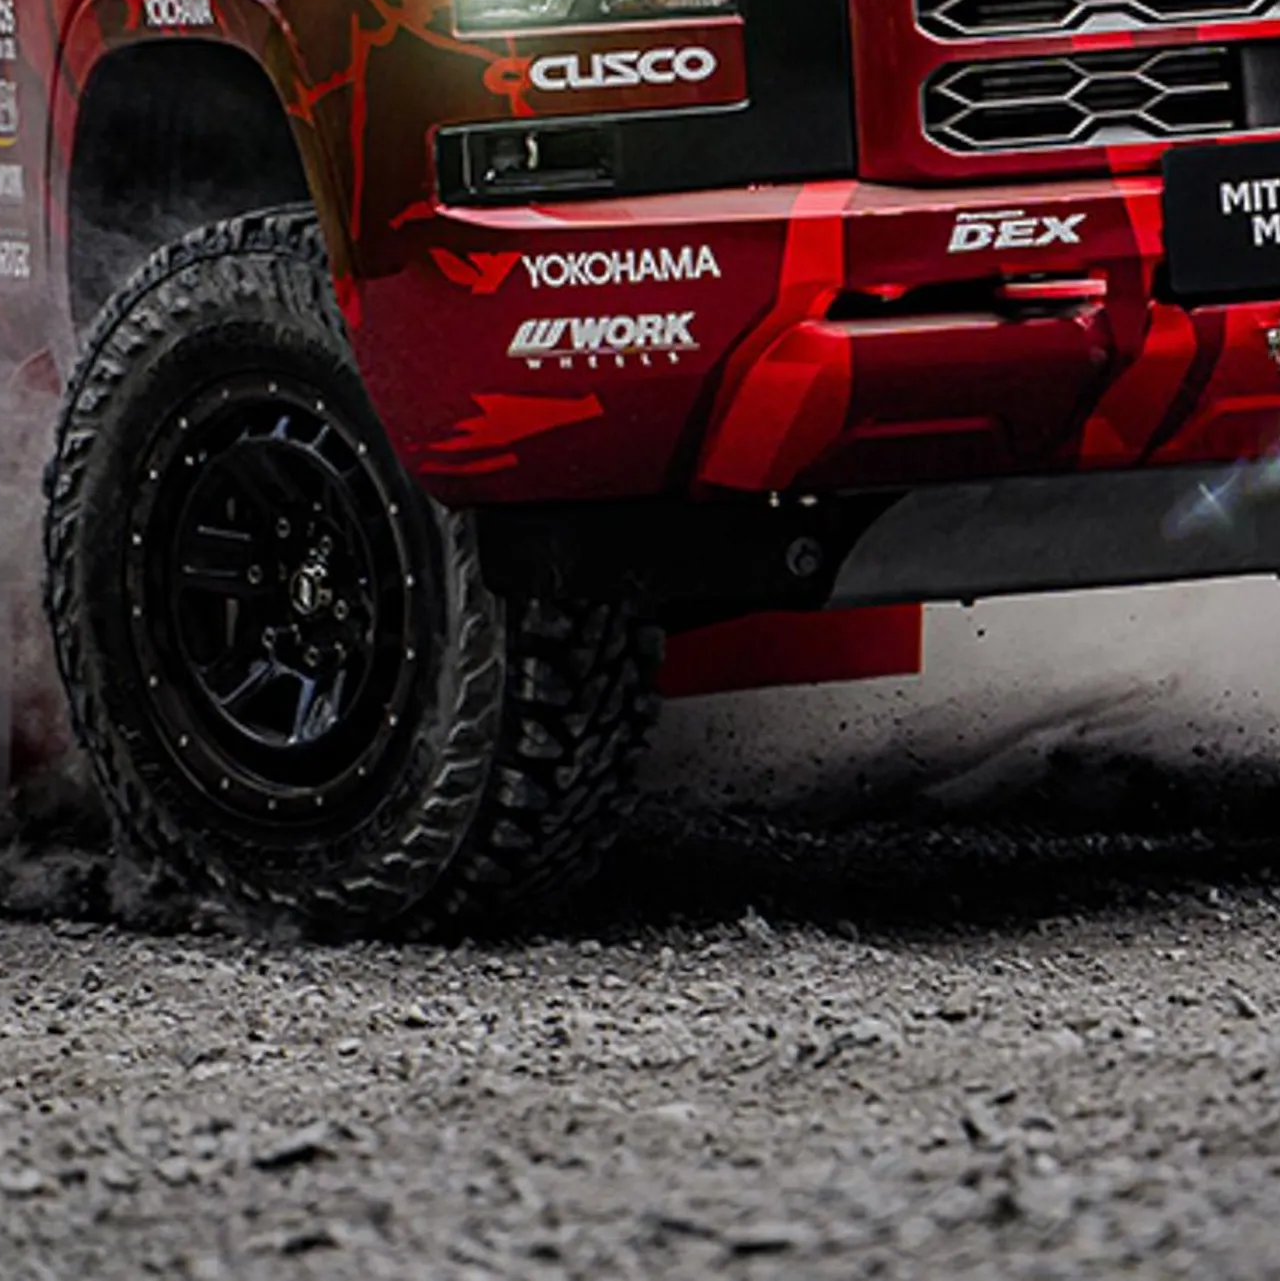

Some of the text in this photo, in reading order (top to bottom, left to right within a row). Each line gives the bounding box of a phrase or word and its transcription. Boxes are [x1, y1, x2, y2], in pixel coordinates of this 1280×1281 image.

[528, 46, 717, 91] CUSCO
[947, 212, 1087, 253] DEX
[522, 245, 721, 289] YOKOHAMA
[570, 311, 695, 351] WORK
